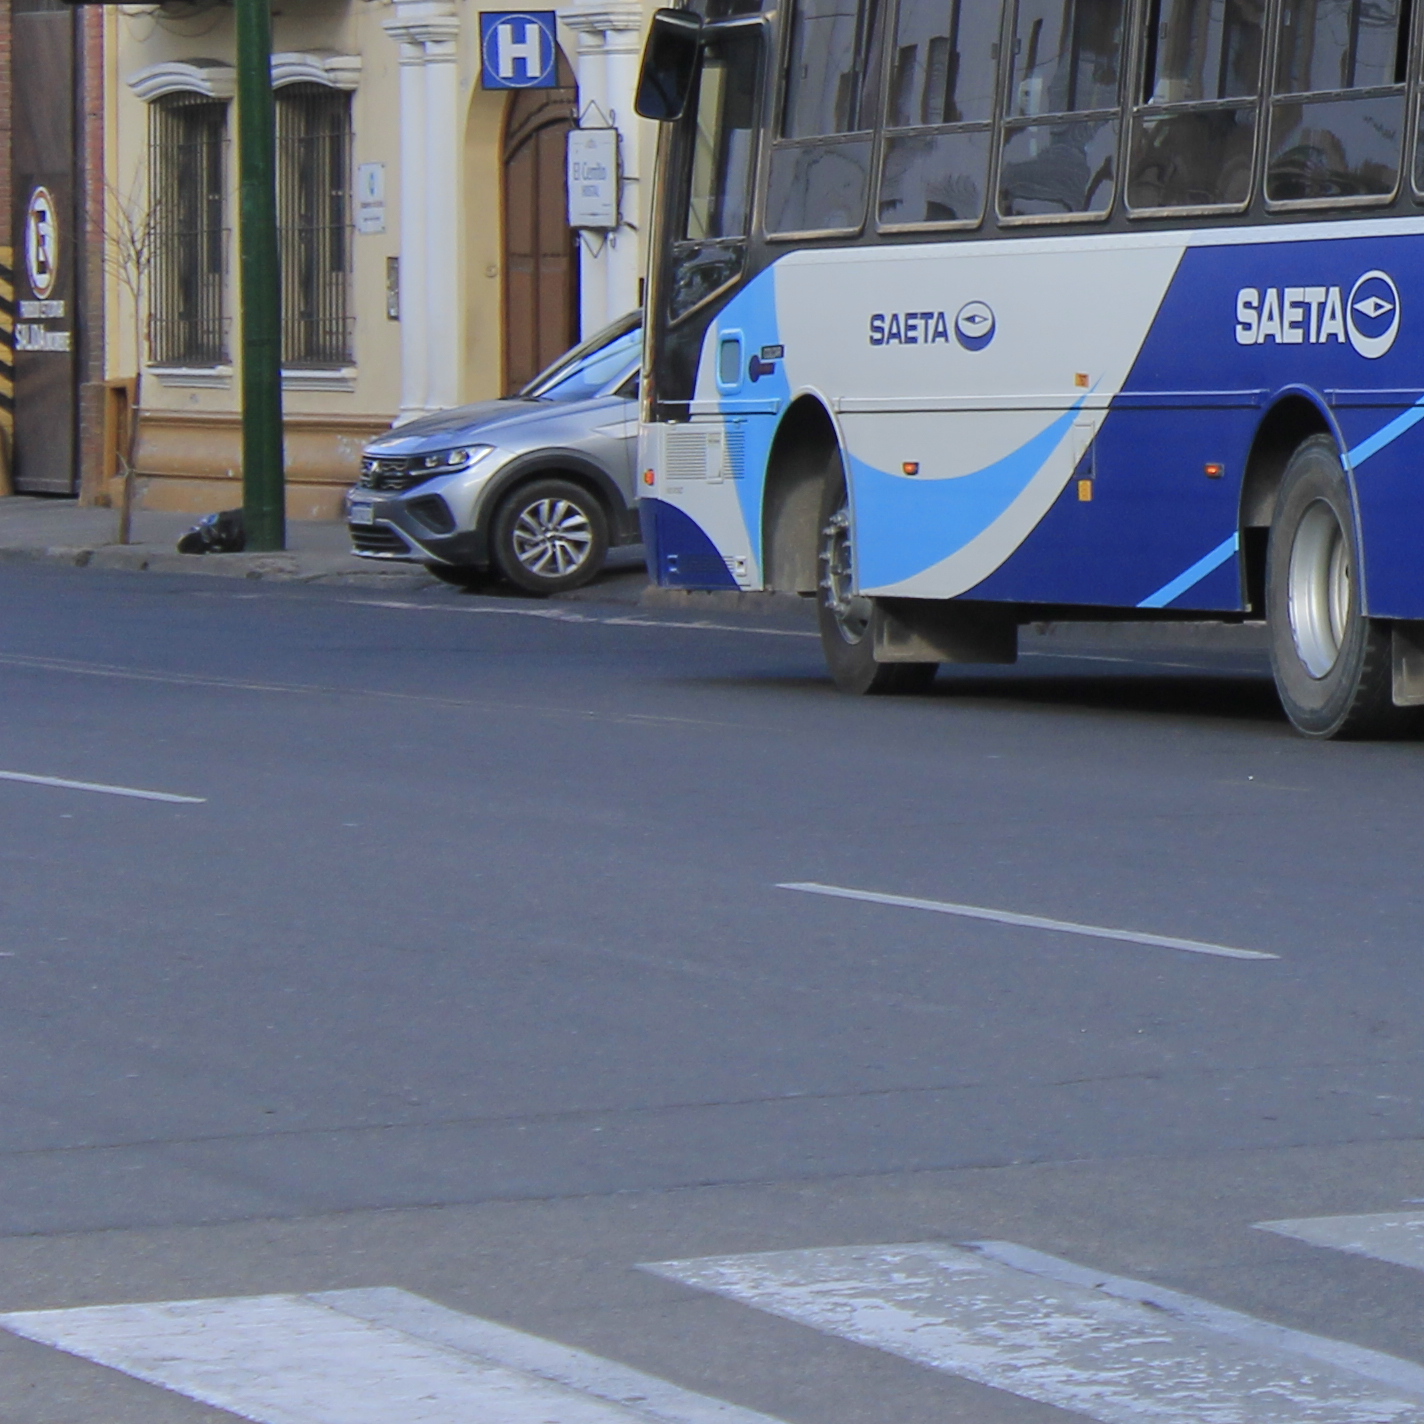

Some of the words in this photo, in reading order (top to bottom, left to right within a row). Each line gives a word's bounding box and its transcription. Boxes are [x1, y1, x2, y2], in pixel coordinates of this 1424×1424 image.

[497, 23, 542, 78] H
[869, 311, 950, 346] SAETA
[1234, 286, 1347, 345] SAETA
